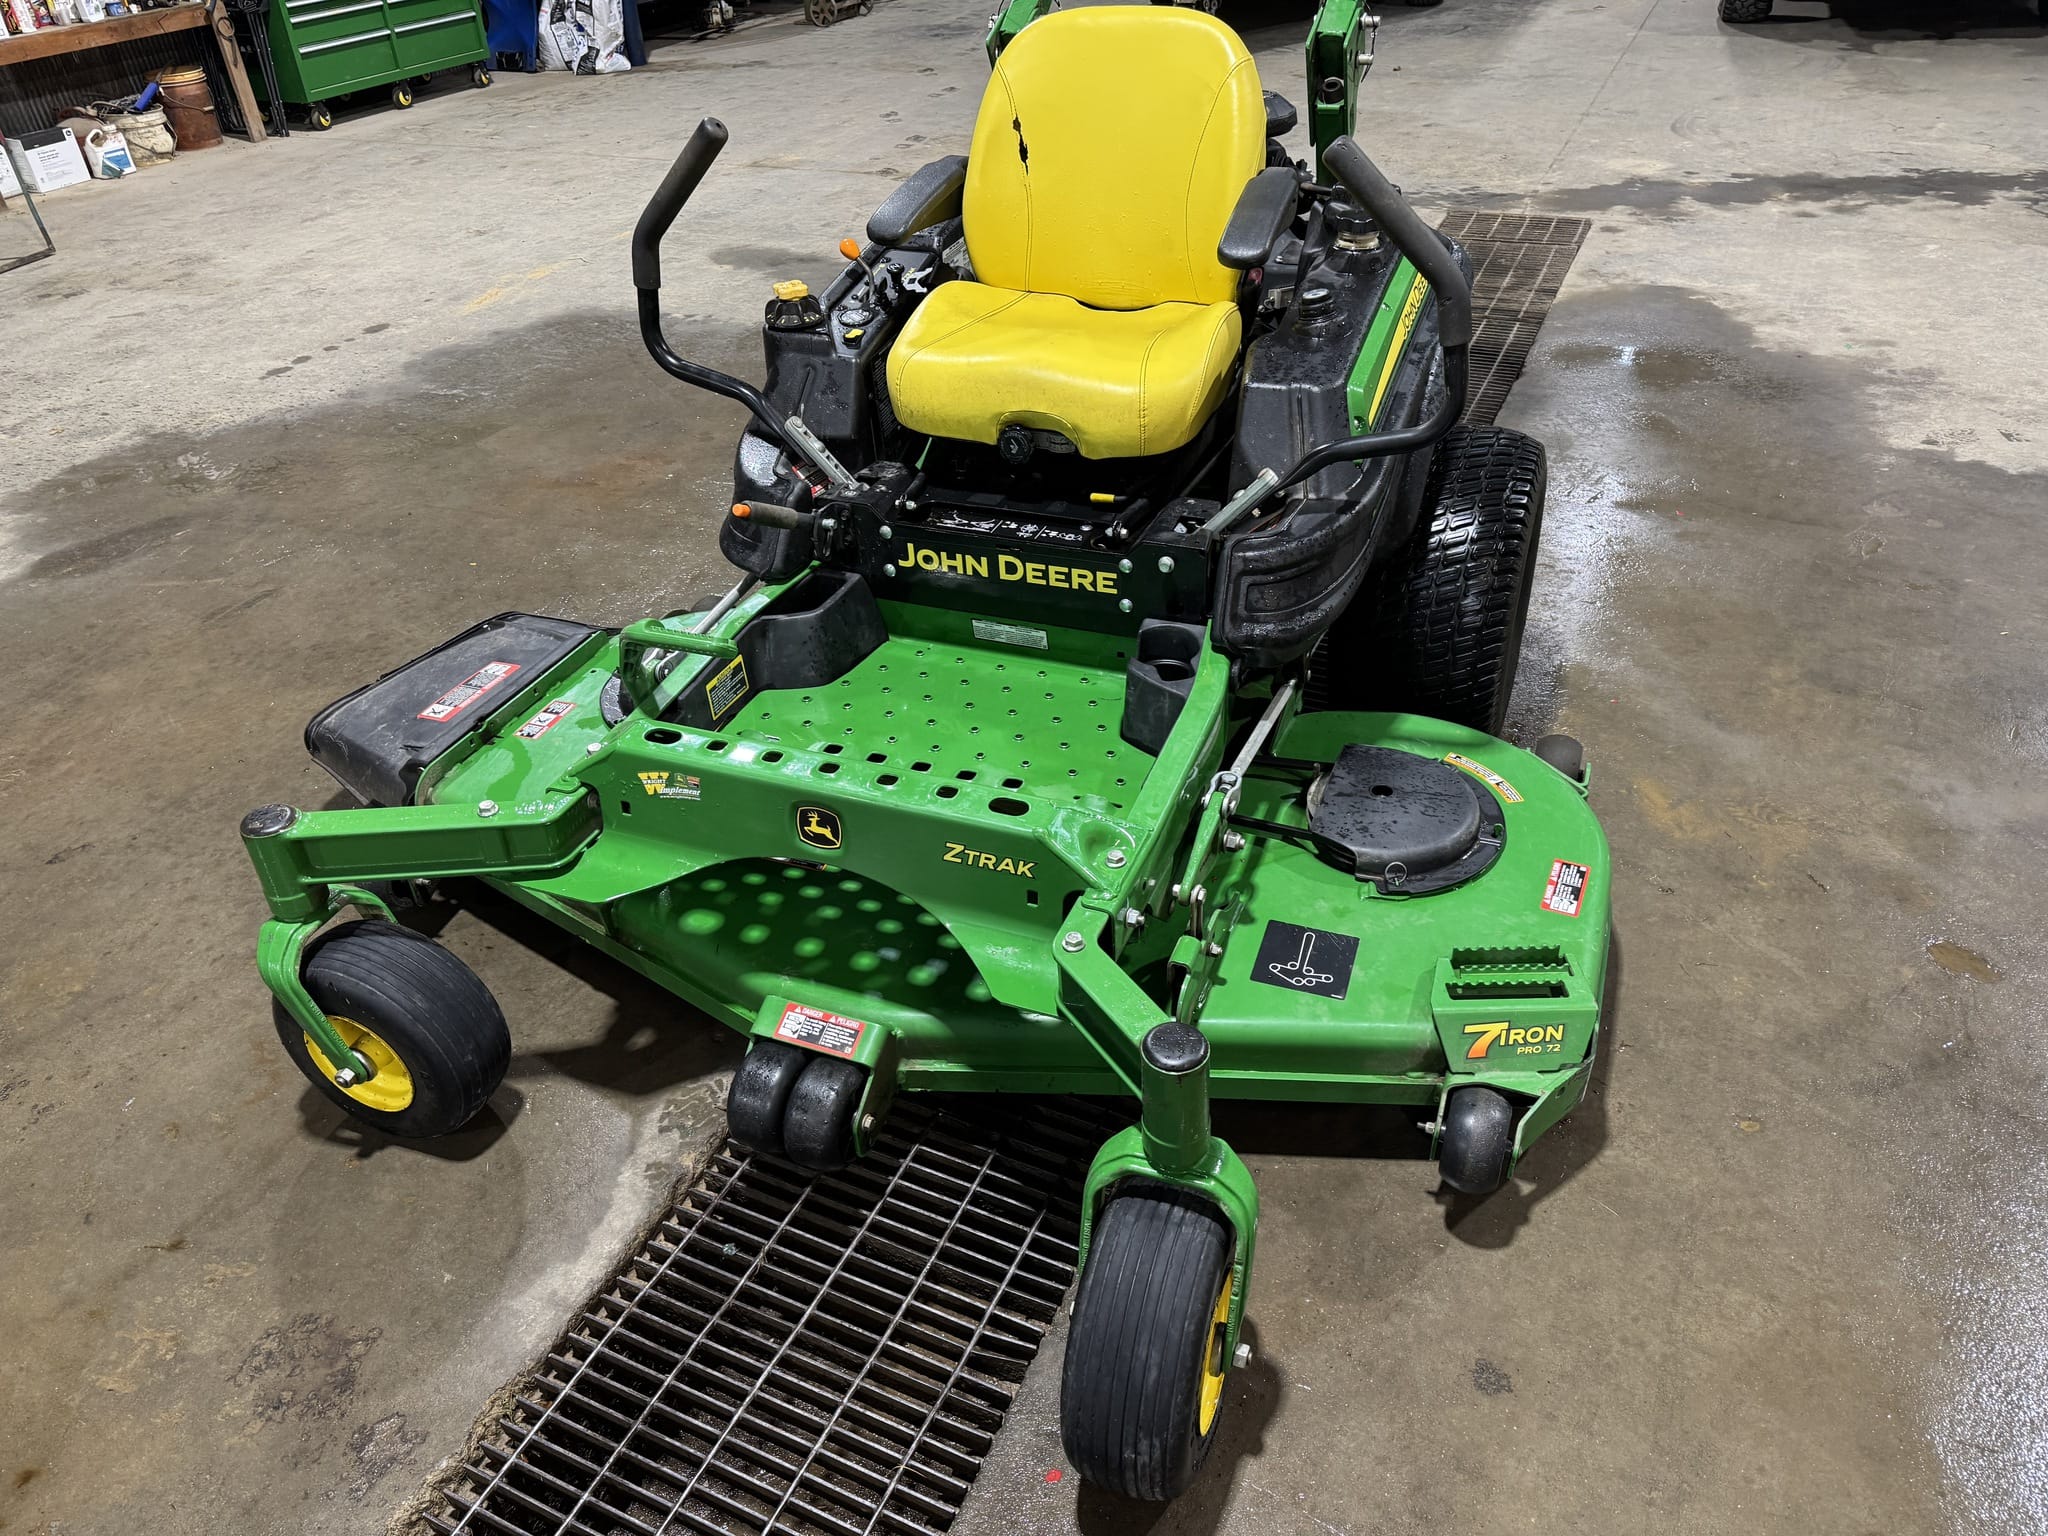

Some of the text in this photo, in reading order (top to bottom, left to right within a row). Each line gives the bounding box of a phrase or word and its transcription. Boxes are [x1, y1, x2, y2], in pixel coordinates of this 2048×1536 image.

[898, 543, 1118, 594] JOHN DEERE
[943, 842, 1036, 878] ZTRAK
[1516, 1043, 1562, 1056] PRO 72
